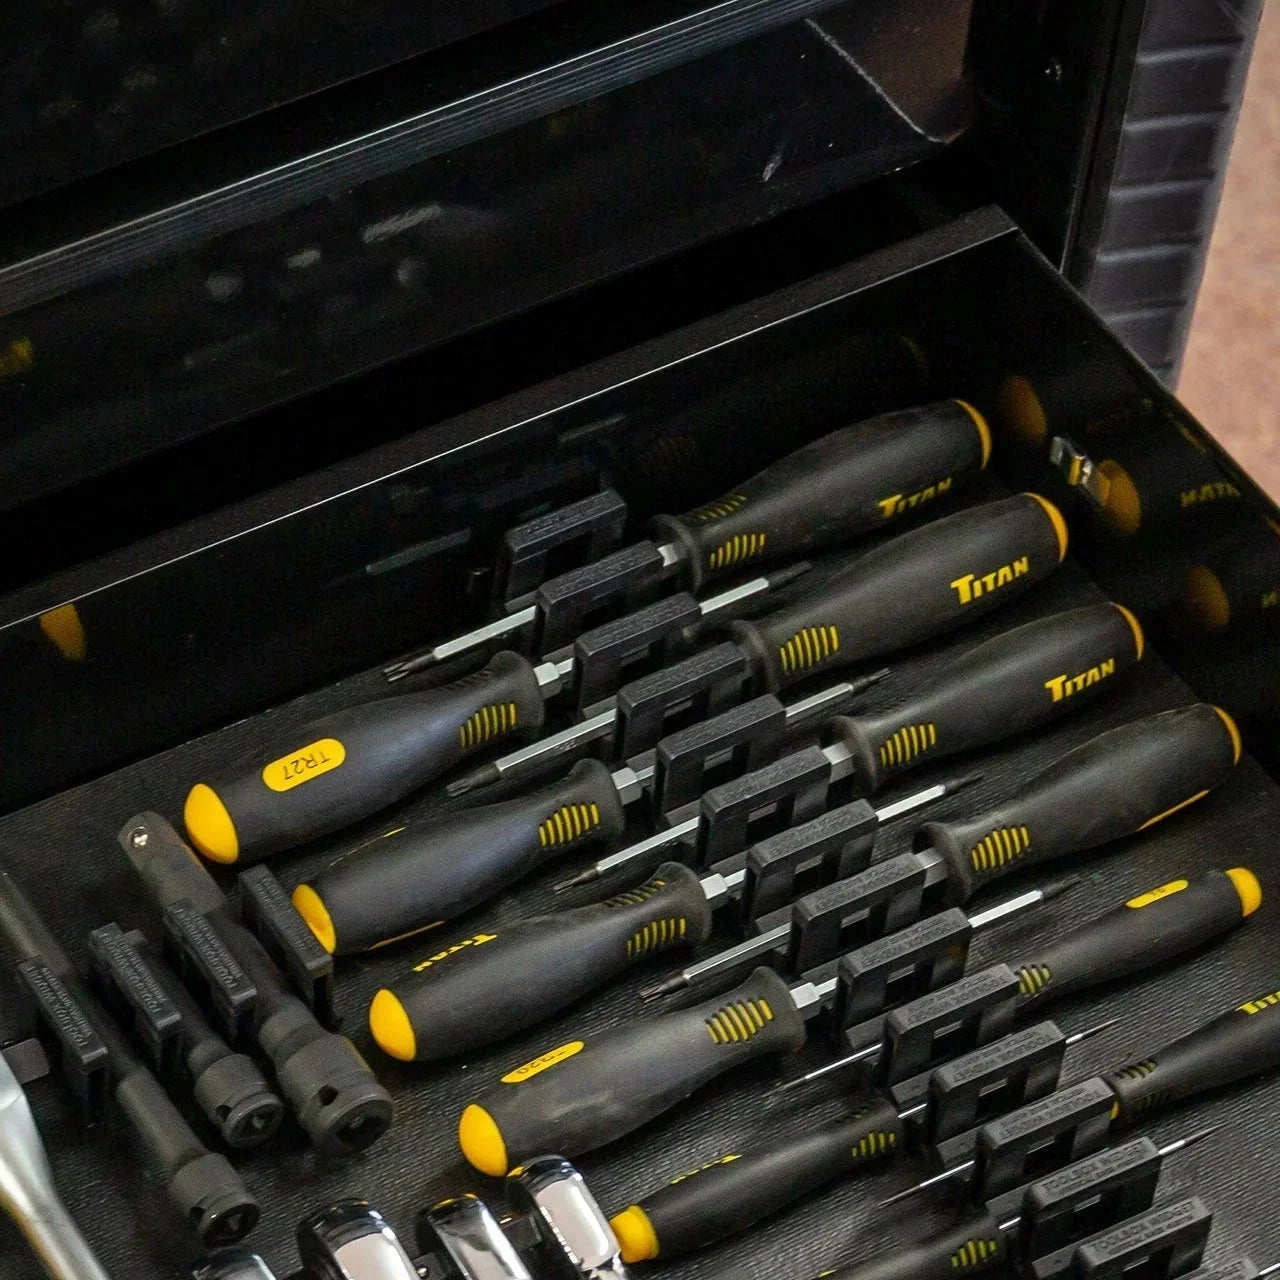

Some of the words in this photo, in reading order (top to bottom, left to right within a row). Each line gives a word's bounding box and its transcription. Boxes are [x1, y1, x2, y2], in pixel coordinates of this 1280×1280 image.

[878, 477, 952, 518] TITAN
[950, 555, 1029, 605] TITAN
[1044, 658, 1115, 702] TITAN
[283, 751, 331, 780] TR27
